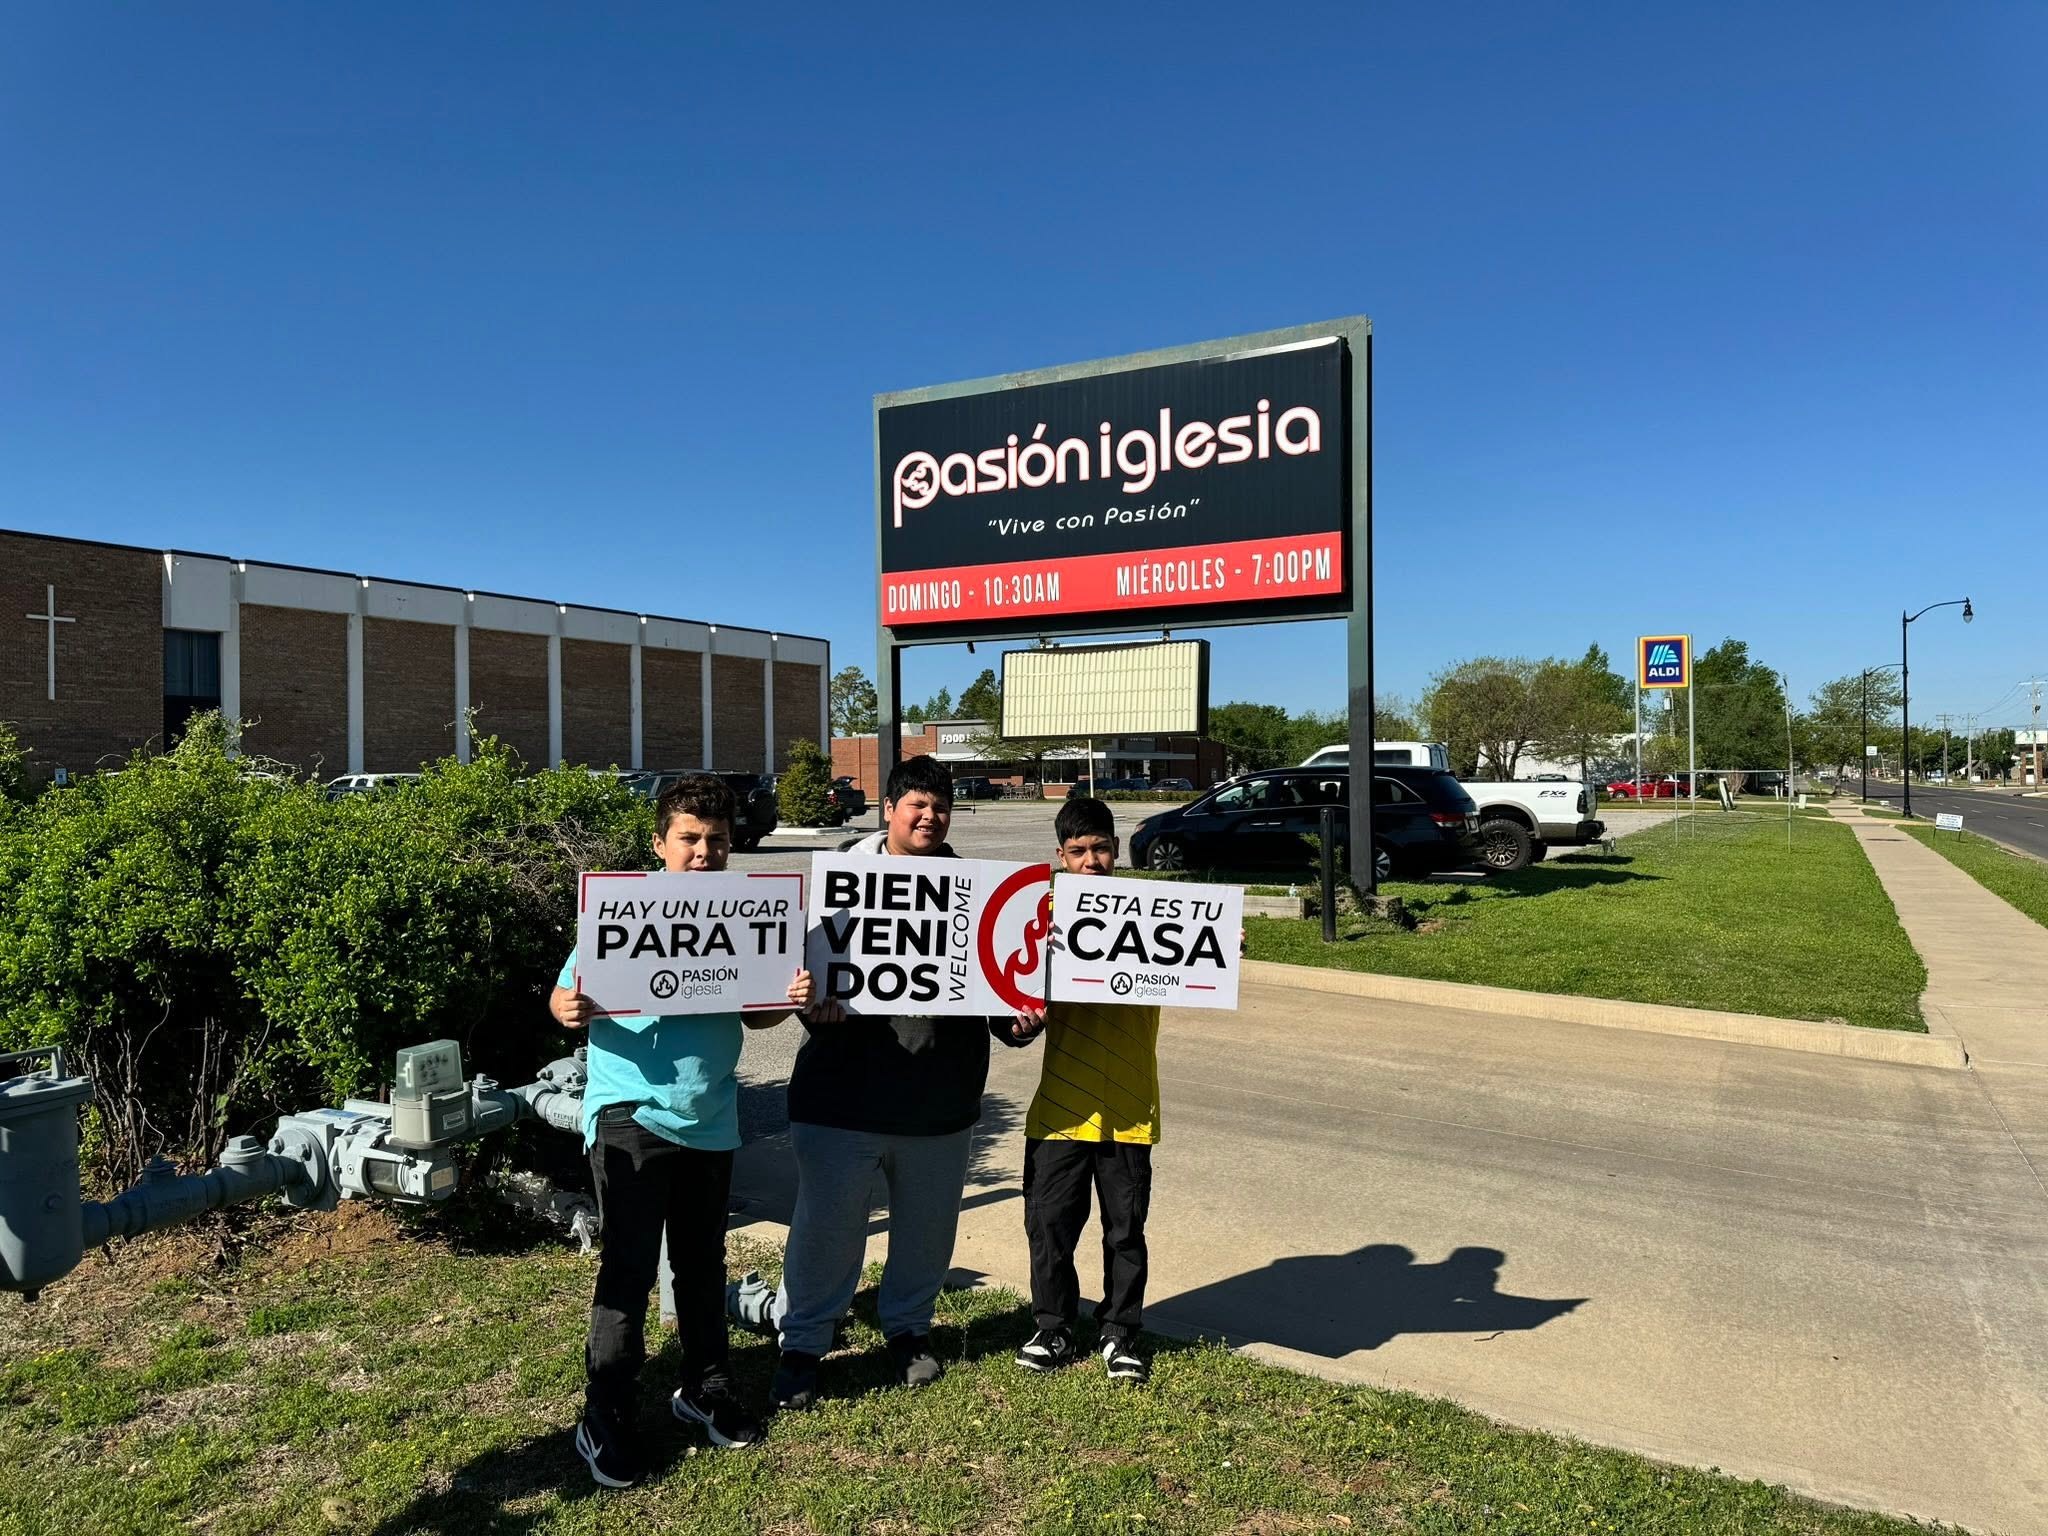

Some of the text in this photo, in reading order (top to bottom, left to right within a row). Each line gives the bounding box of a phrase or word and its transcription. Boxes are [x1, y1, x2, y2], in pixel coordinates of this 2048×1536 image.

[1099, 398, 1321, 494] iglesia
[1056, 514, 1094, 530] con
[1116, 557, 1226, 597] MIÉRCOLES
[1252, 547, 1331, 585] 7:00PM
[888, 580, 961, 613] DOMINGO
[984, 572, 1061, 606] 10:30AM
[1648, 667, 1680, 677] ALDI
[941, 733, 965, 744] FOOD
[824, 870, 950, 912] BIEN
[1076, 892, 1224, 922] ESTA ES TU
[598, 899, 789, 920] HAY UN LUGAR
[597, 921, 787, 960] PARA TI
[820, 916, 948, 957] VENI
[949, 875, 972, 1002] WELCOME
[1067, 917, 1227, 969] CASA
[681, 983, 722, 999] iglesia
[682, 965, 738, 983] PASIÓN
[826, 962, 940, 1002] DOS
[1135, 972, 1180, 986] PASIÓN
[1135, 985, 1167, 998] iglesia
